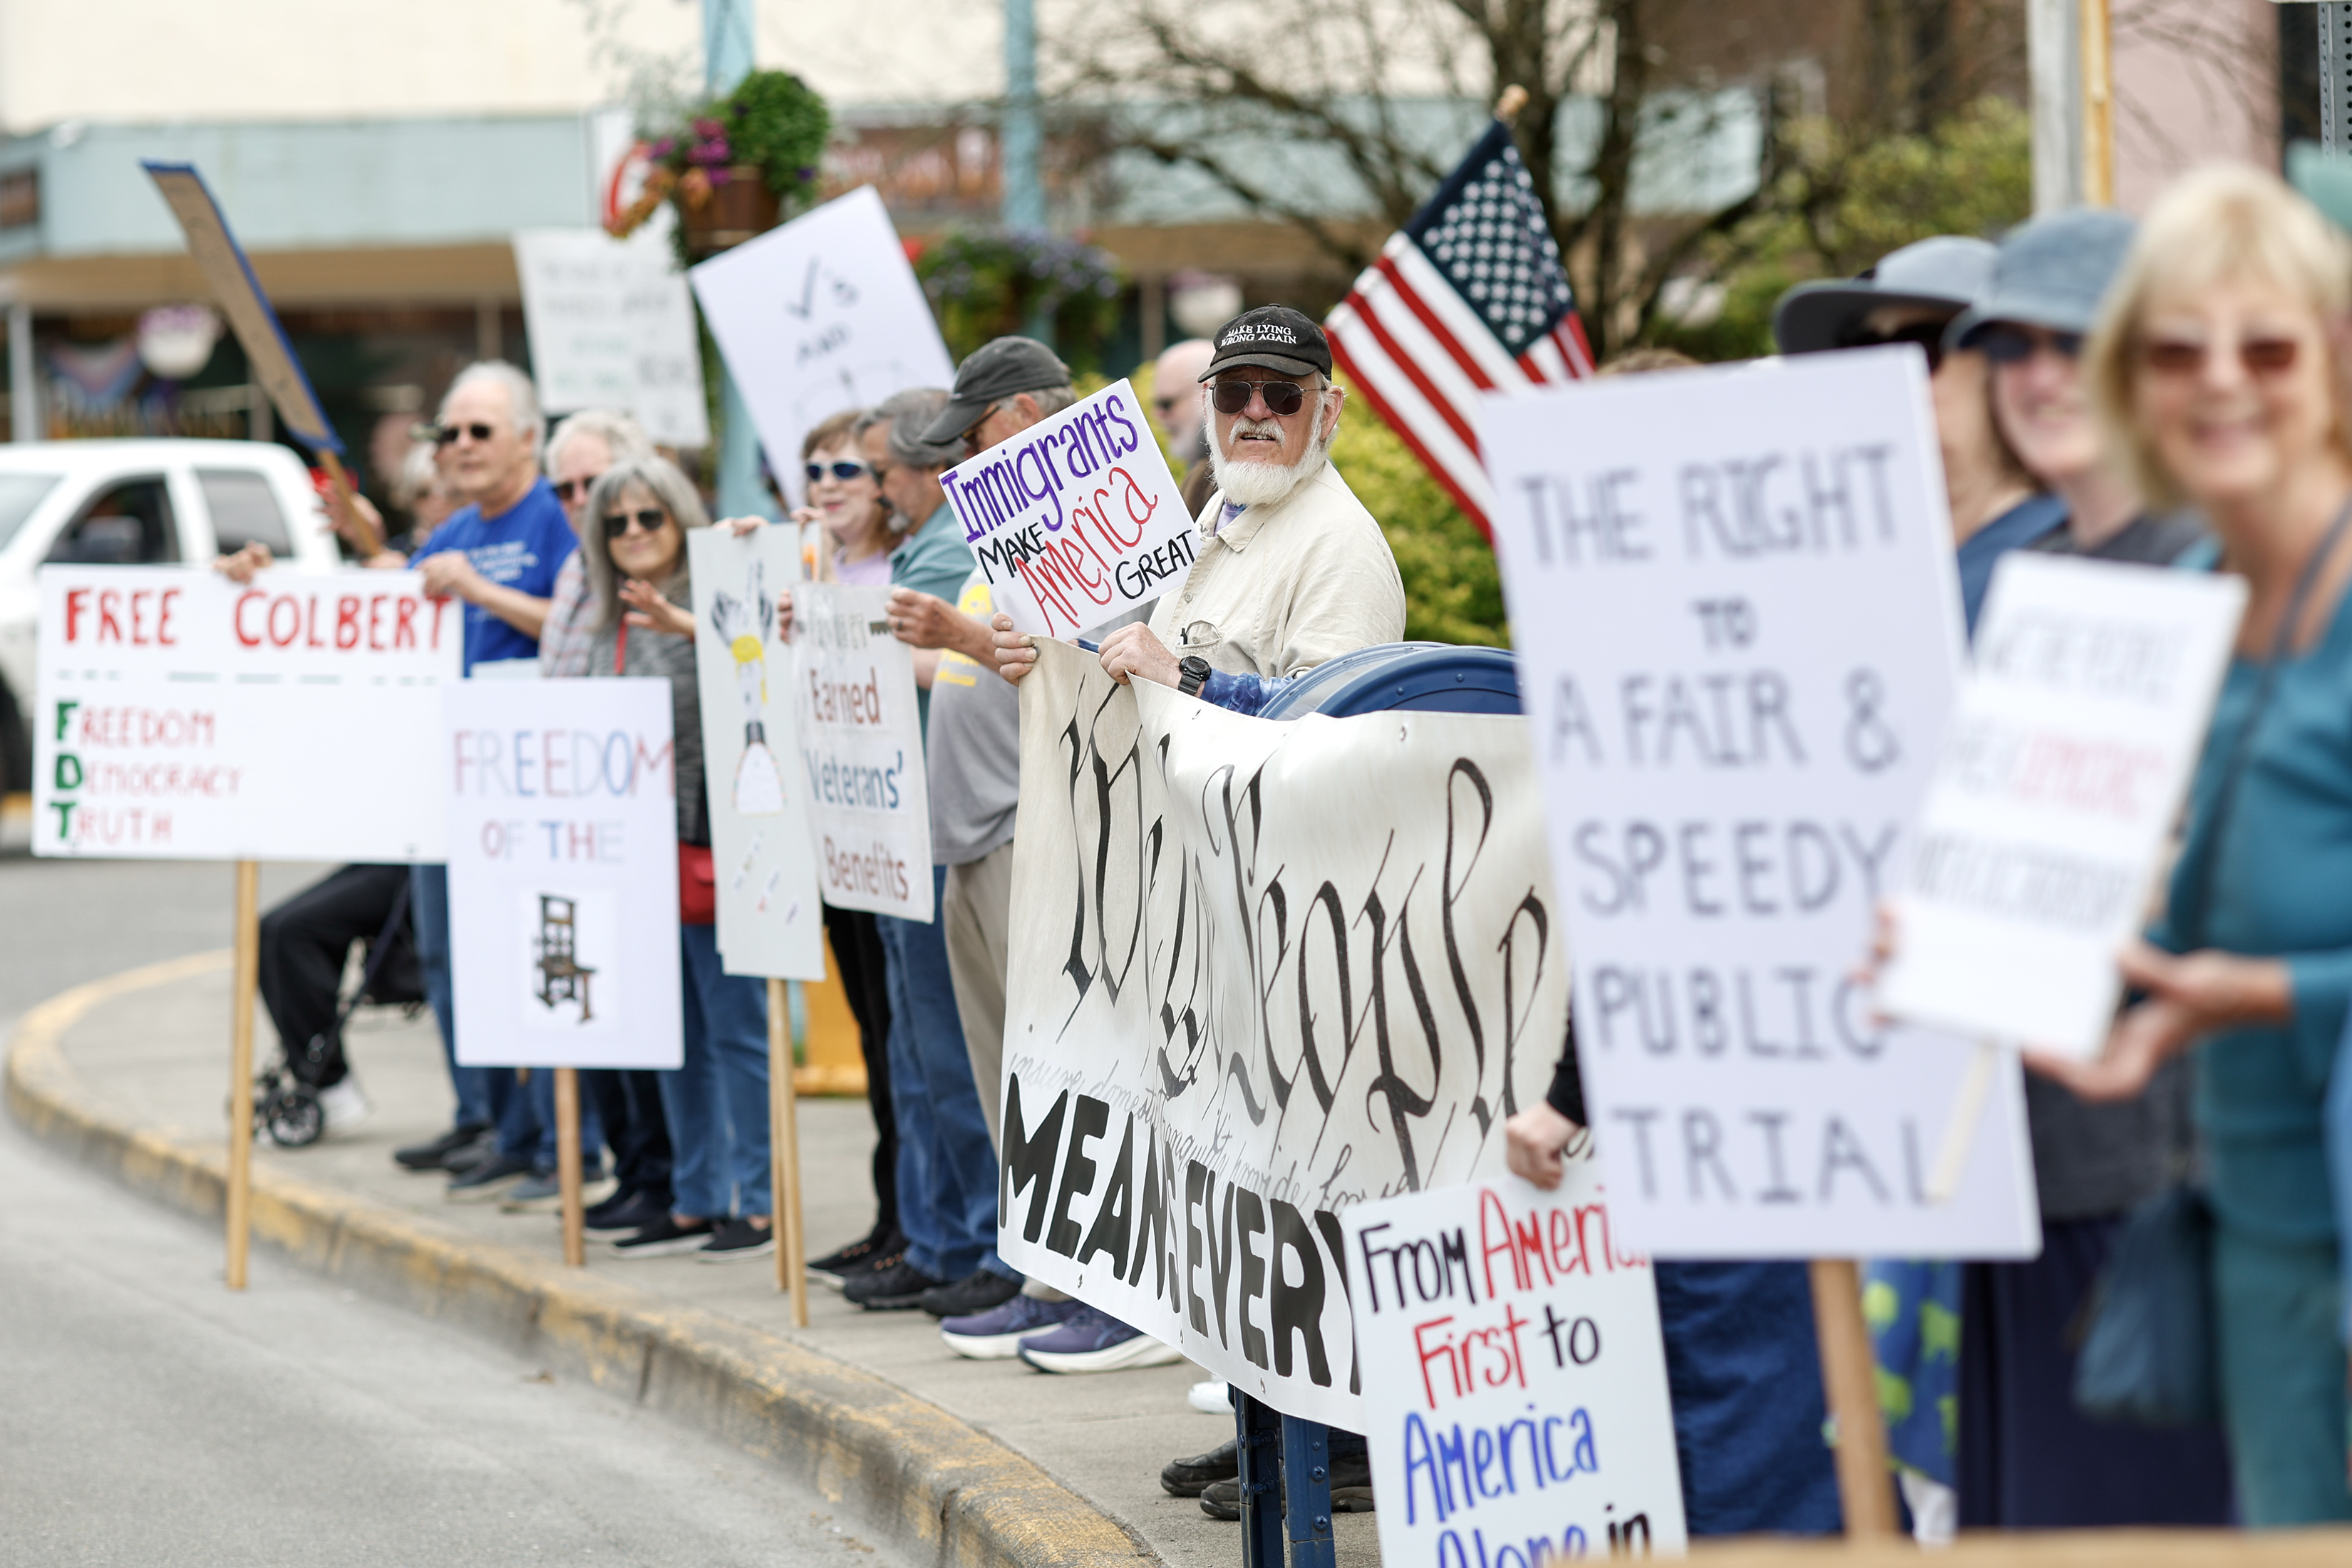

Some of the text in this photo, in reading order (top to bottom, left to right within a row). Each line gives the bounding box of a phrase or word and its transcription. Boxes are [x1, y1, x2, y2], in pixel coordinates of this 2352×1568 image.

[1221, 333, 1296, 346] WRONG AGAIN
[1226, 324, 1291, 338] MAKE LYING
[941, 395, 1138, 542] Immigrants
[1517, 442, 1902, 567] THE RIGHT
[978, 522, 1046, 584] MAKE
[1115, 530, 1195, 599] GREAT
[63, 587, 454, 652] FREE COLBERT
[1689, 596, 1757, 650] TO
[56, 701, 216, 748] FREEDOM
[810, 667, 882, 724] Earned
[1549, 671, 1605, 770] A
[1619, 669, 1808, 768] FAIR
[1842, 664, 1902, 775] &
[55, 753, 241, 797] DEMOCRACY
[455, 729, 676, 798] FREEDOM
[49, 801, 172, 845] TRUTH
[481, 820, 624, 863] OF THE
[825, 834, 909, 901] Benefits
[1572, 817, 1902, 919] SPEEDY
[1593, 962, 1889, 1062] PUBLIC
[1609, 1105, 1933, 1208] TRIAL
[1413, 1304, 1600, 1410] First to
